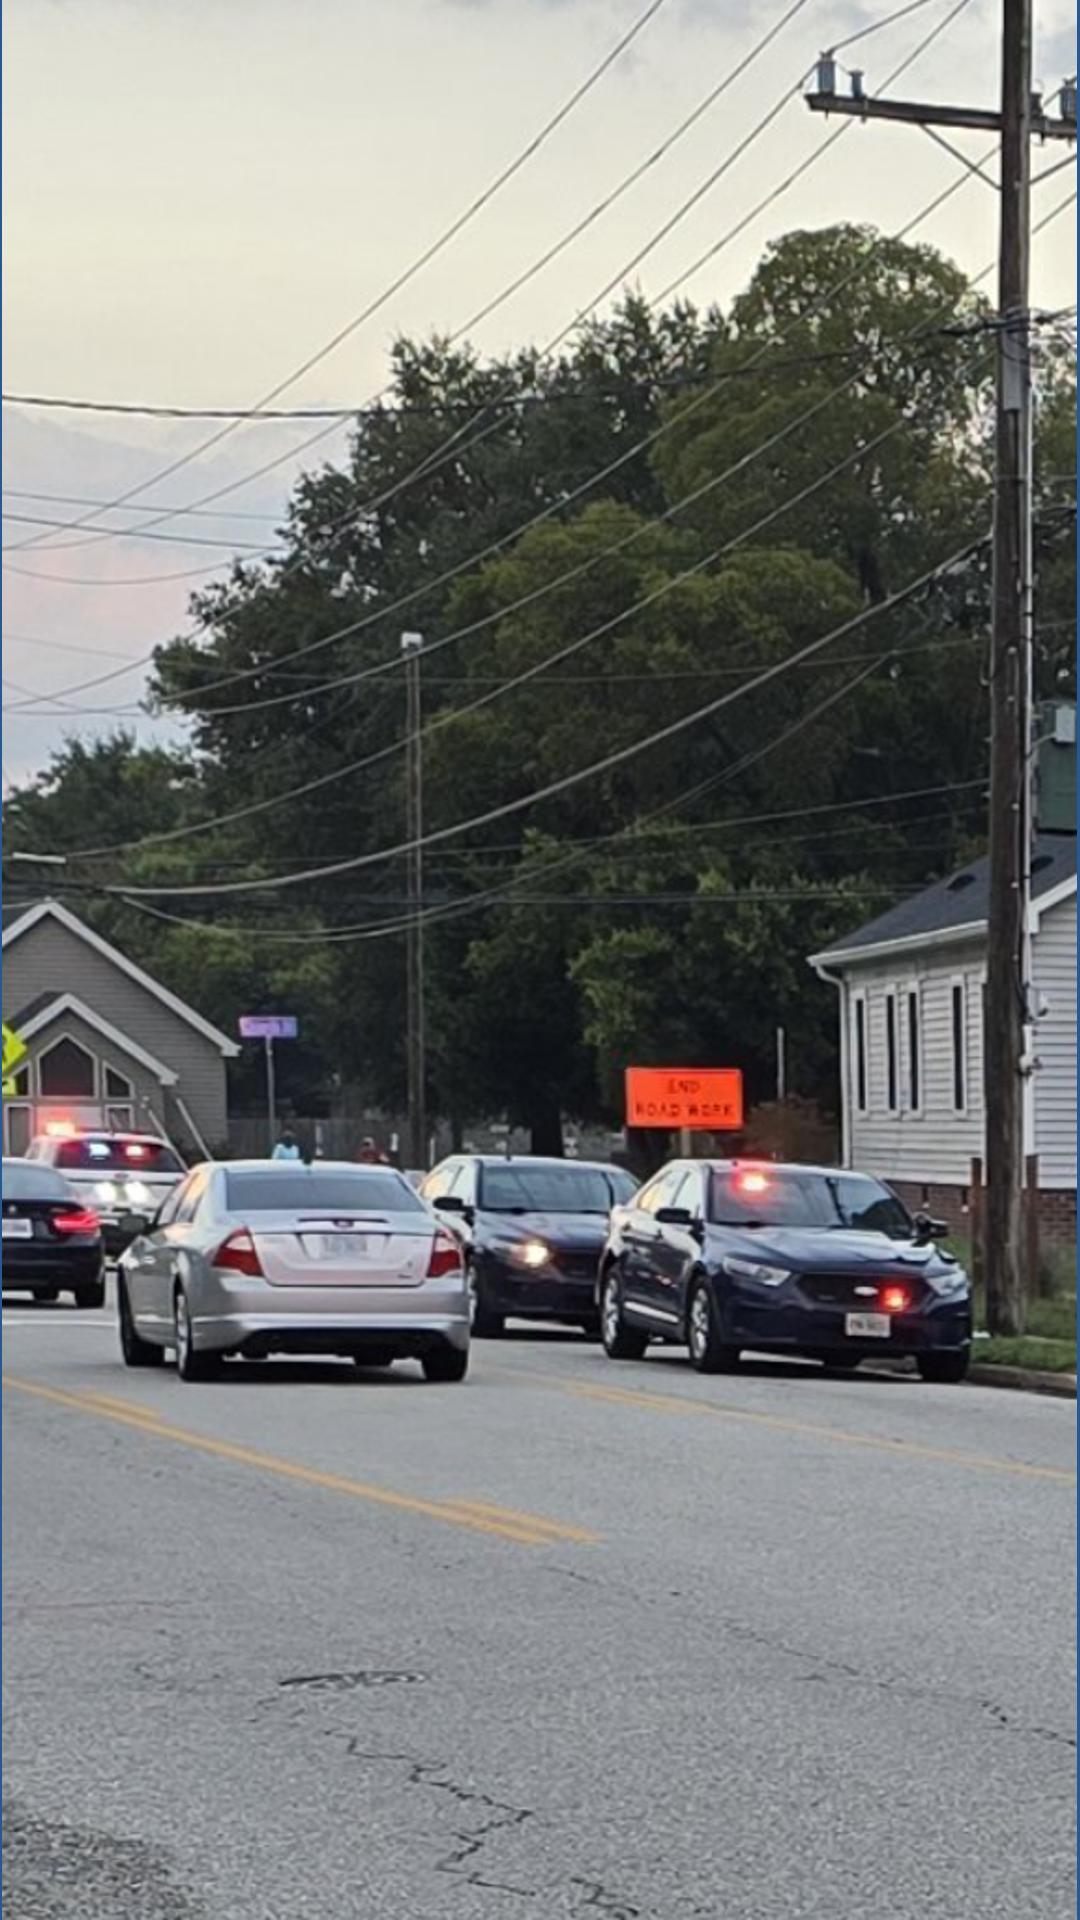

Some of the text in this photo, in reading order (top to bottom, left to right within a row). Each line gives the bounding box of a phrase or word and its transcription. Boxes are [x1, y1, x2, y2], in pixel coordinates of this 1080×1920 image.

[667, 1078, 701, 1094] END
[635, 1102, 732, 1117] ROAD WORK
